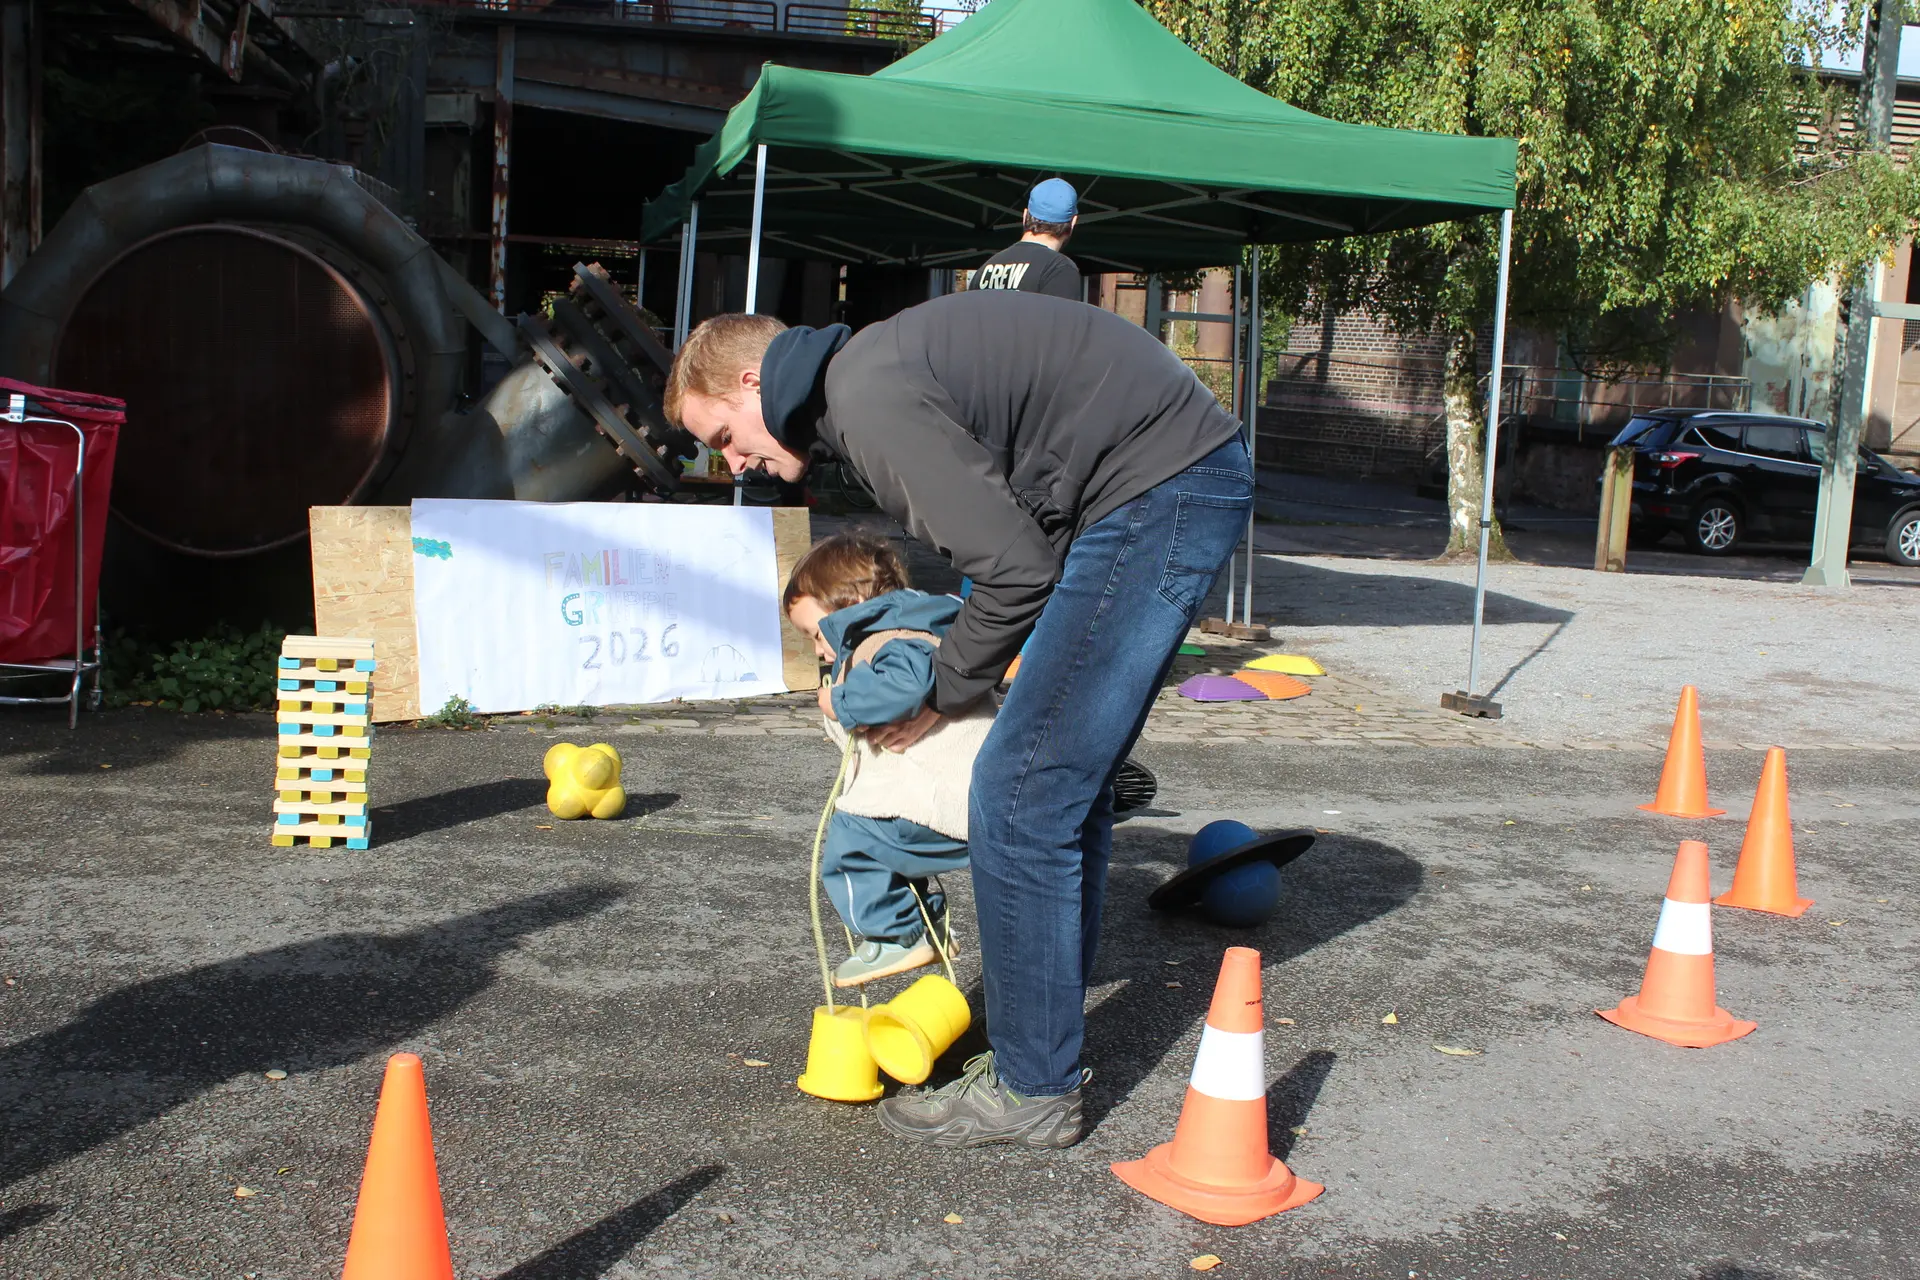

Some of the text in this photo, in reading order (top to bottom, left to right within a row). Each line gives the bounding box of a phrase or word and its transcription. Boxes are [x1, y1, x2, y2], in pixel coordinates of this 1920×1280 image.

[979, 263, 1030, 290] CREW
[543, 548, 686, 589] FAMILIEN-
[561, 591, 678, 627] GRUPPE
[579, 623, 680, 670] 2026
